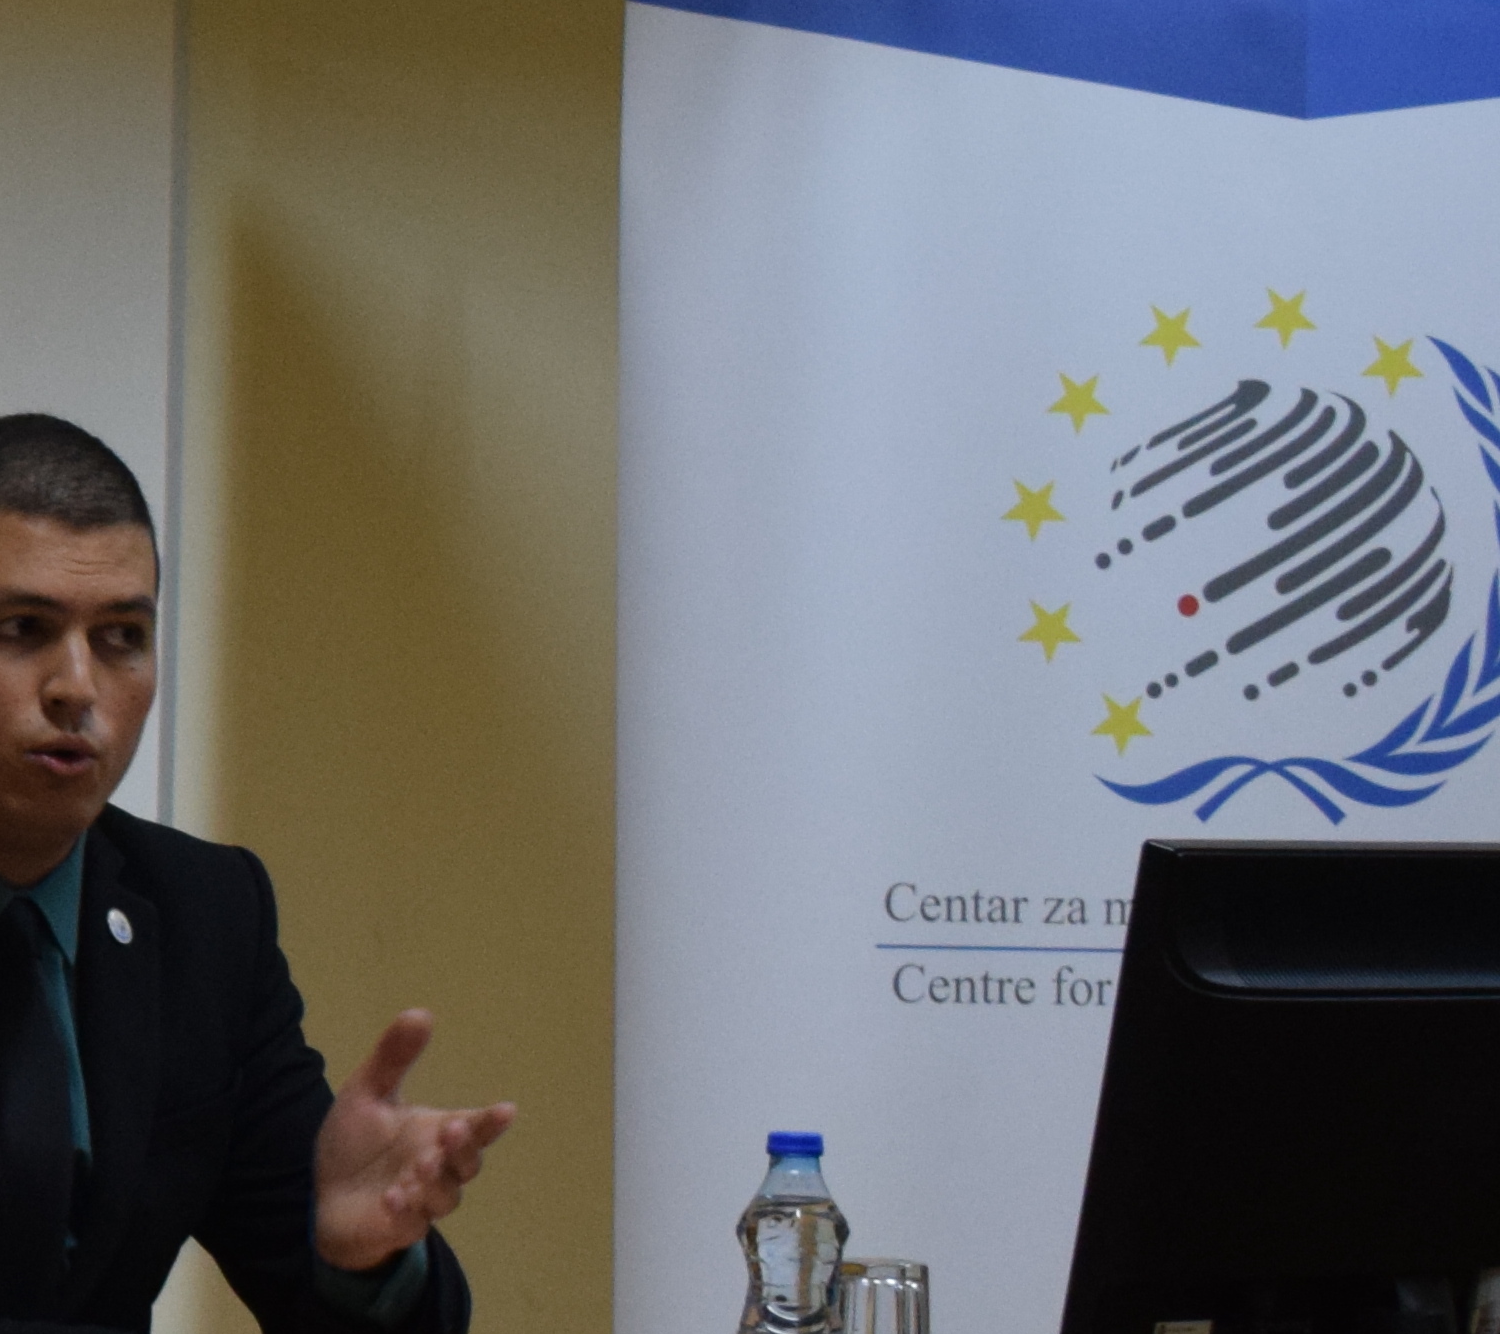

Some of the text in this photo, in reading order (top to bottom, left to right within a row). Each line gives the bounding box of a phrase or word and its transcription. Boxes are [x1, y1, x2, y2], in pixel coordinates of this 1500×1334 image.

[884, 883, 1028, 923] Centar
[1044, 897, 1088, 925] za
[892, 964, 1112, 1006] Centre for
